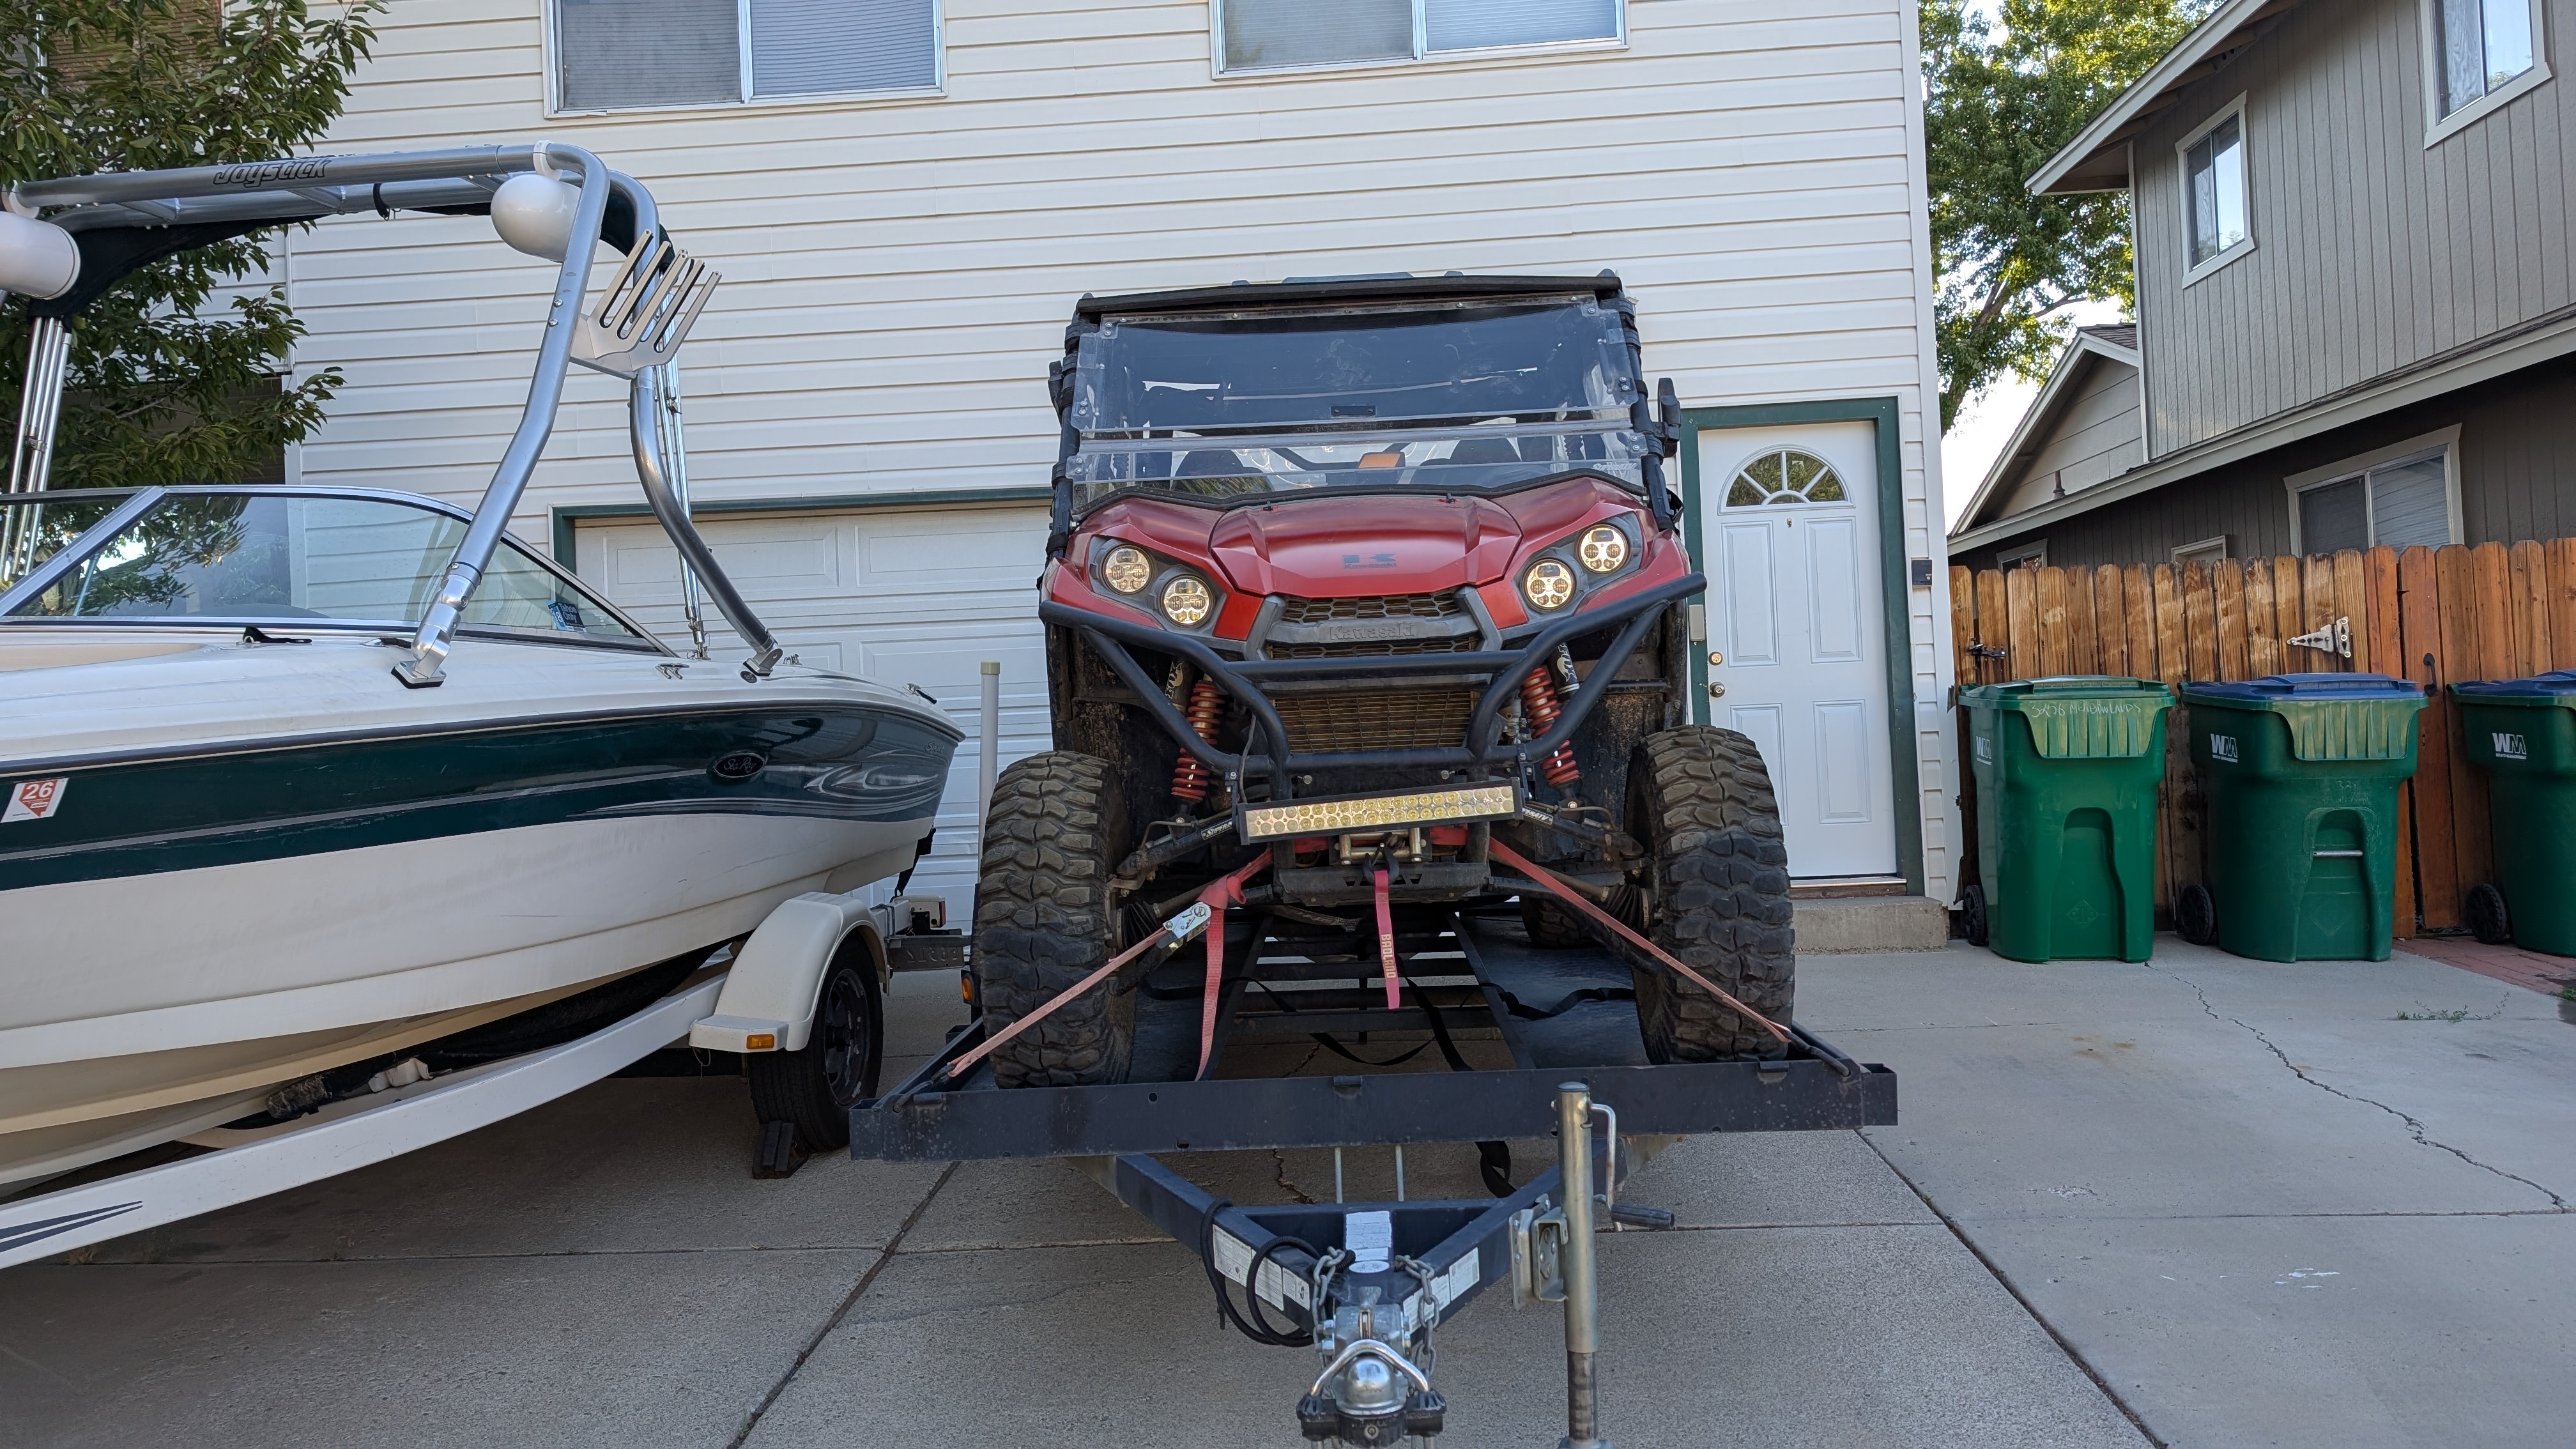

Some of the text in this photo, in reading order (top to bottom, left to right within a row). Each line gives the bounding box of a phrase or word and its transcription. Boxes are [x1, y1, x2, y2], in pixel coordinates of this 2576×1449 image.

[213, 159, 332, 188] Joystick
[558, 603, 578, 613] Tahoe
[562, 611, 577, 623] Only
[1330, 623, 1414, 640] Kawasaki
[2211, 733, 2238, 758] WM
[2492, 732, 2527, 755] WM
[22, 781, 54, 800] 26
[1381, 934, 1396, 979] BADLAND
